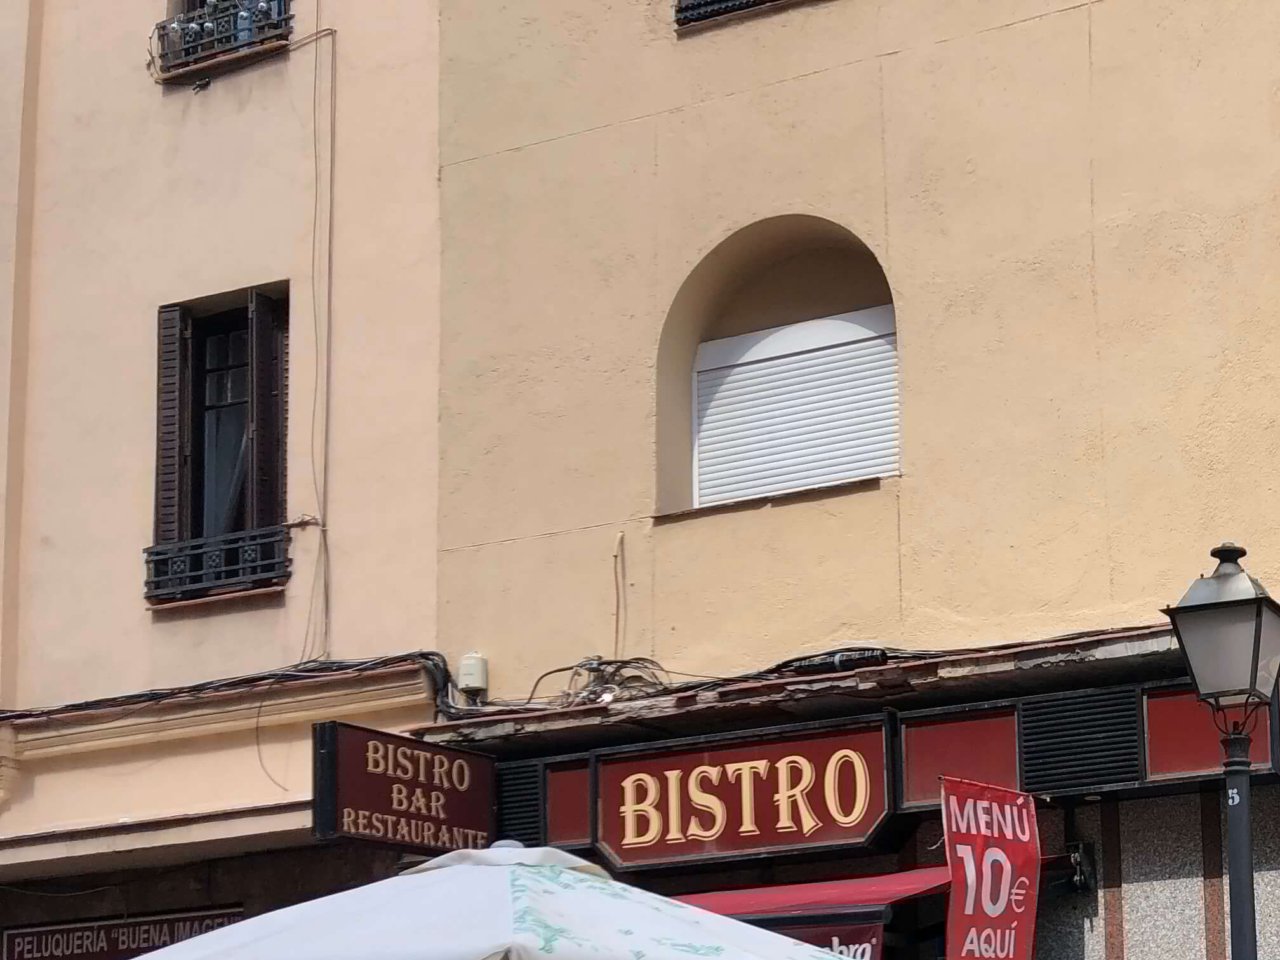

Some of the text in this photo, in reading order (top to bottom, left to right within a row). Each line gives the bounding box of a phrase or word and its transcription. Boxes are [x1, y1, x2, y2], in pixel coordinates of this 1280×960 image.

[366, 740, 470, 792] BISTRO
[391, 783, 446, 820] BAR
[618, 748, 872, 850] BISTRO
[1228, 788, 1240, 806] 5
[342, 808, 488, 850] RESTAURANTE
[949, 795, 1030, 842] MENÚ
[14, 925, 108, 960] PELUQUERÍA
[961, 921, 1018, 959] AQUÍ
